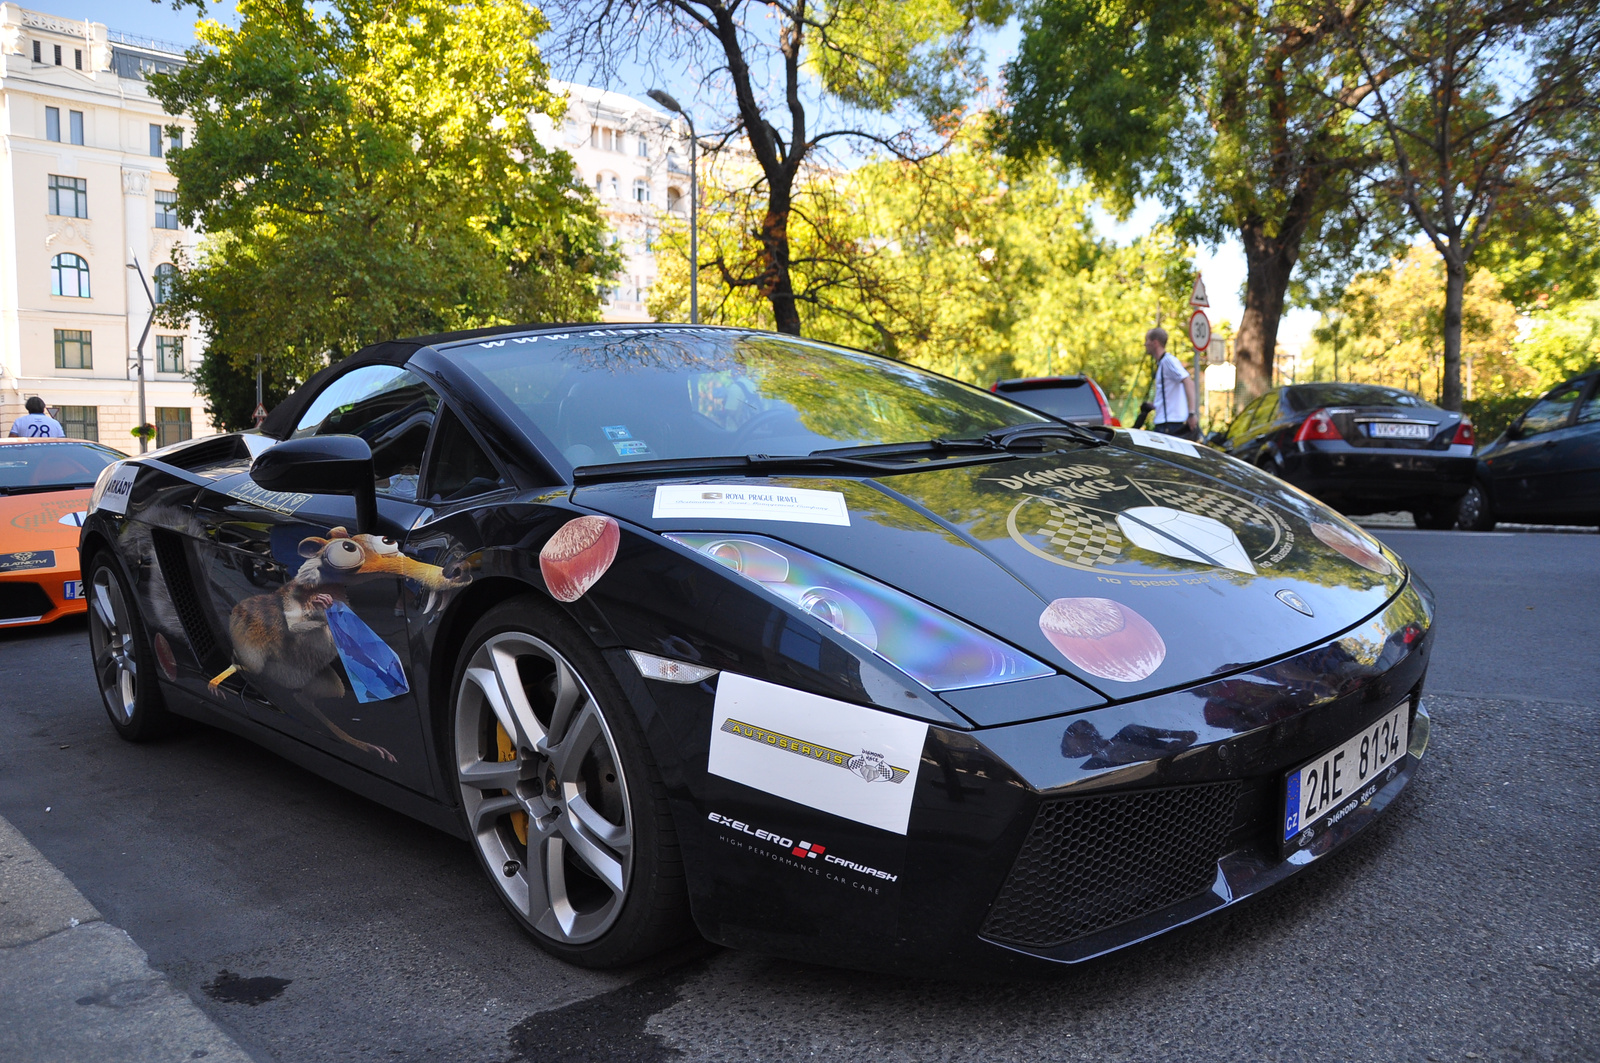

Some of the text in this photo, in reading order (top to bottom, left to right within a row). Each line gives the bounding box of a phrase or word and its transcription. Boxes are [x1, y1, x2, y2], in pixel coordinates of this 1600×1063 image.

[1195, 321, 1207, 338] 30
[28, 424, 50, 437] 28
[980, 463, 1111, 490] DIAMOND
[748, 494, 773, 502] PRAGUE
[777, 495, 798, 503] TRAVEL
[1050, 479, 1130, 500] RACE
[1259, 561, 1273, 569] no
[1097, 571, 1239, 588] no speed too fast
[732, 724, 842, 764] AUTOSERVIS
[1305, 713, 1399, 820] 2AE 8134
[1326, 784, 1377, 827] DIAMOND RACE
[1286, 812, 1298, 831] CZ
[707, 811, 898, 883] EXELERO CARWASH
[719, 834, 880, 895] HIGH PERFORMANCE CAR CARE
